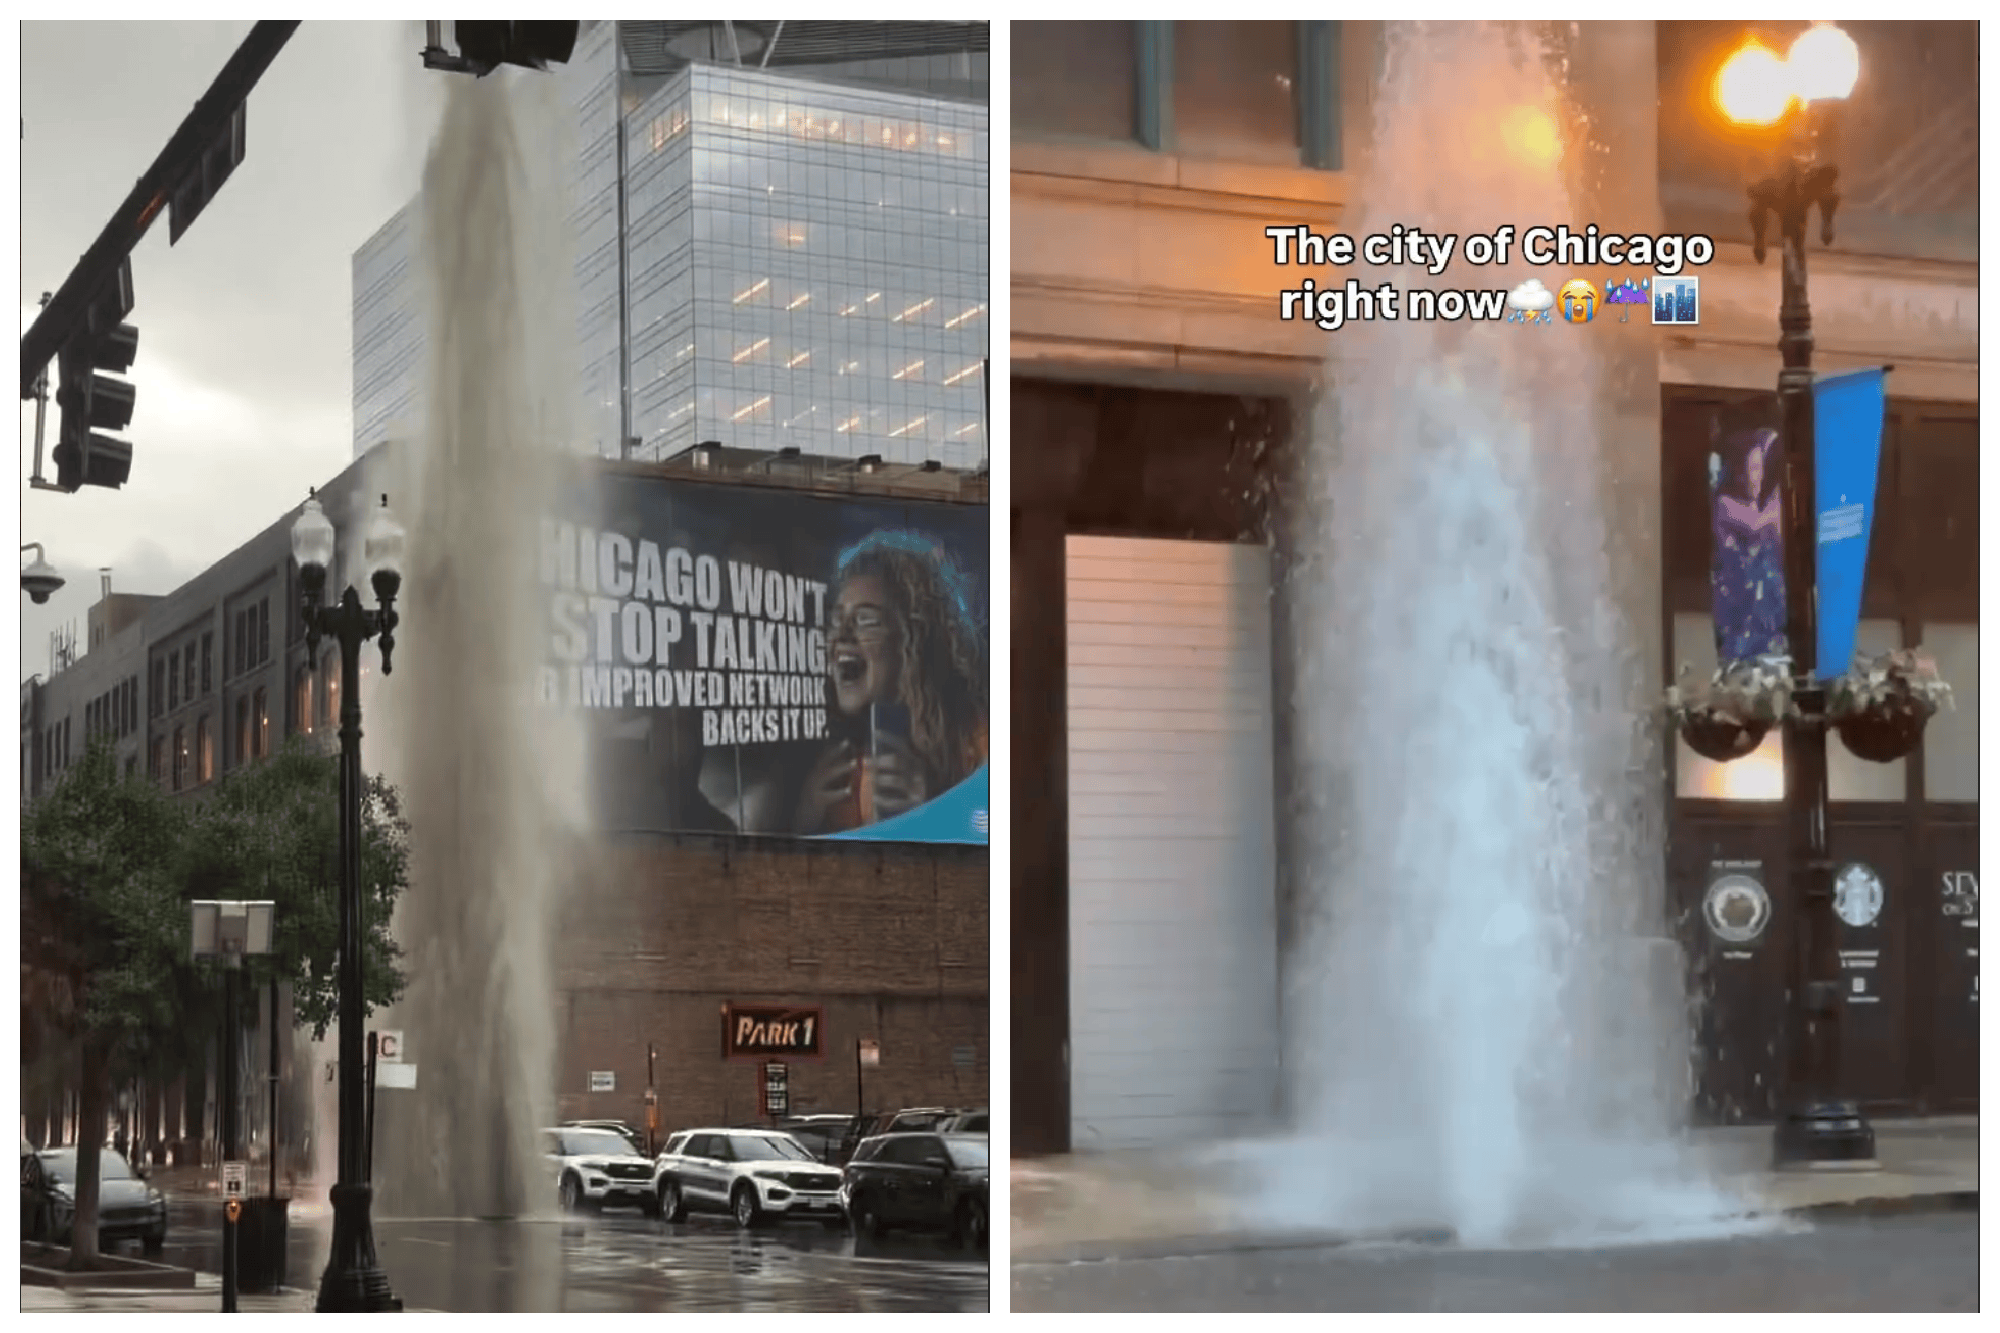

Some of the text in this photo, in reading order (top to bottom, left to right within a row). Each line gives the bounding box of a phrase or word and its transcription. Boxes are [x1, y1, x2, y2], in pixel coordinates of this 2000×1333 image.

[539, 514, 828, 627] HICAGO WON'T
[551, 592, 682, 668] STOP
[567, 665, 725, 708] IMPROVED
[729, 671, 826, 708] NETWORK
[703, 708, 780, 747] BACKS
[782, 707, 800, 742] IT
[735, 1015, 815, 1047] PARK 1
